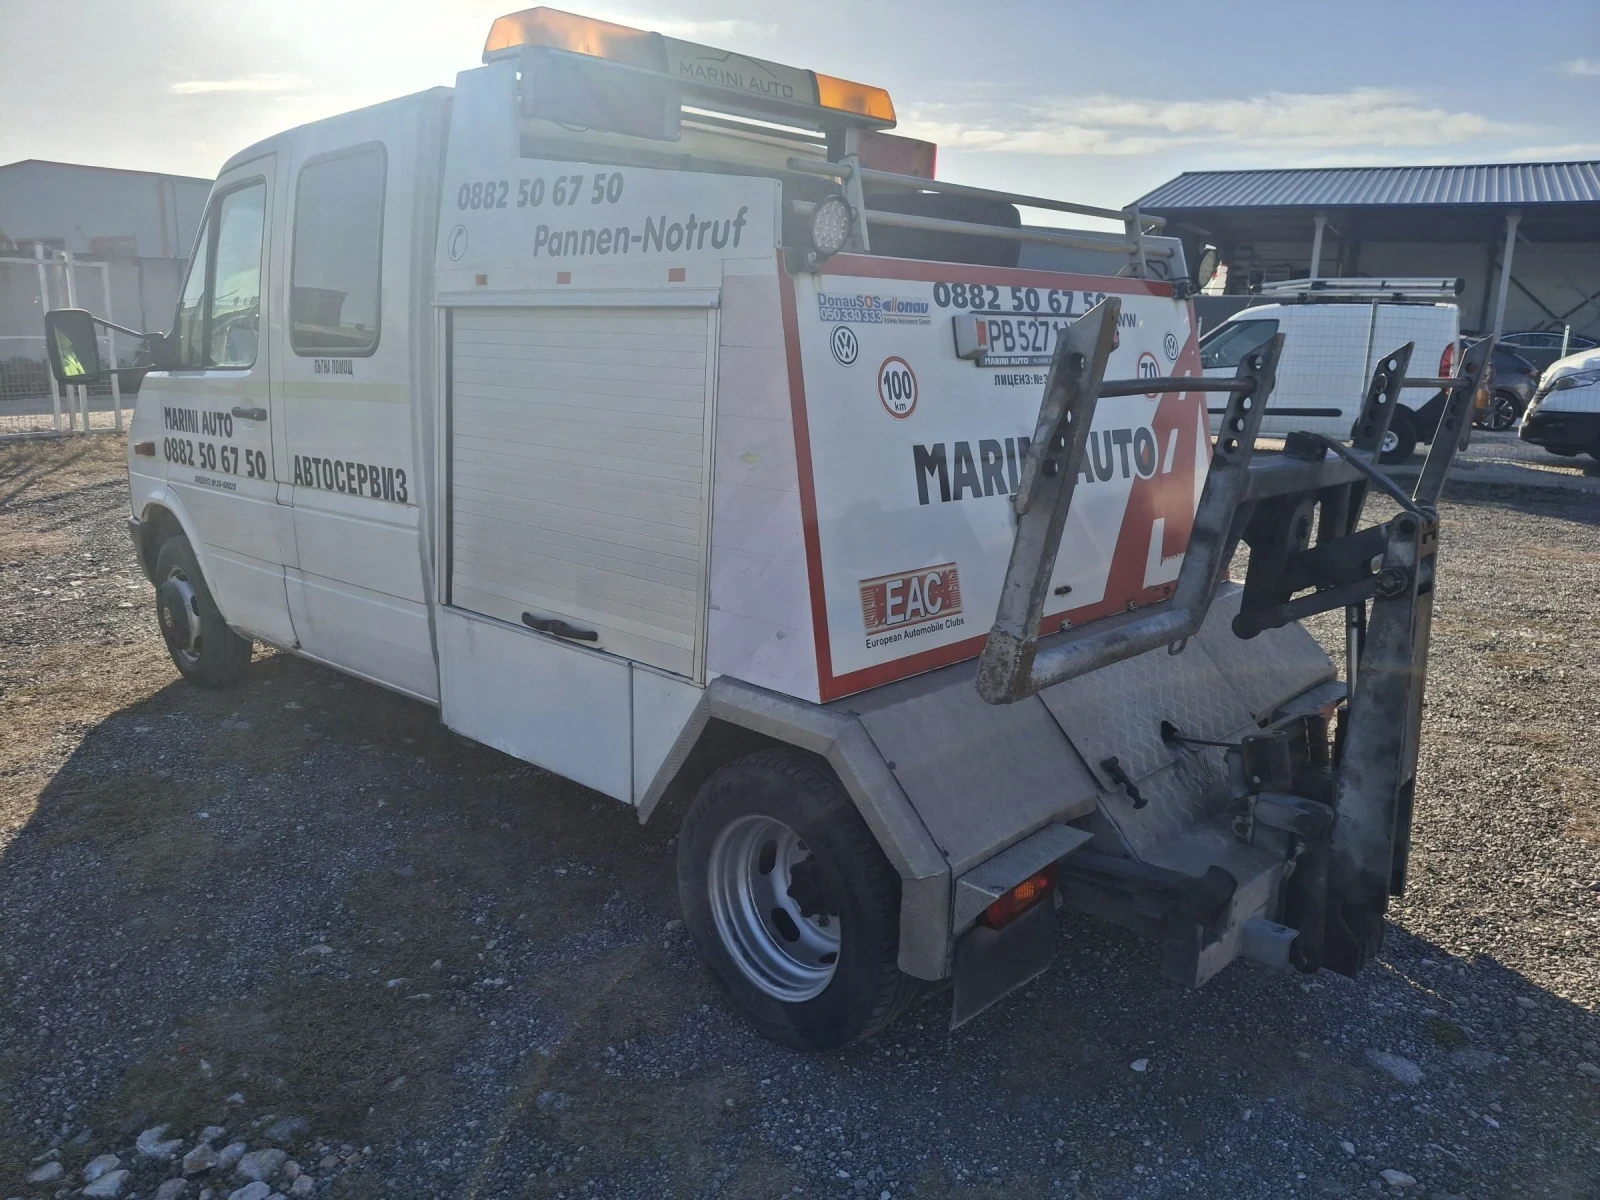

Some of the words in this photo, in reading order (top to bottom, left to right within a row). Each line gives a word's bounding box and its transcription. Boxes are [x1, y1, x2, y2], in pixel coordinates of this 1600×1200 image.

[679, 60, 743, 88] MARINI
[749, 77, 793, 99] AUTO
[457, 180, 509, 211] 0882
[516, 177, 545, 208] 50
[552, 174, 584, 207] 67
[590, 171, 624, 205] 50
[533, 205, 748, 257] Pannen-Notruf
[817, 292, 881, 309] DonauSOS
[933, 281, 1000, 310] 0882
[1011, 286, 1040, 312] 50
[1048, 288, 1074, 314] 67
[984, 357, 1009, 365] MARINI
[1010, 357, 1029, 365] AUTO
[883, 370, 912, 400] 100
[164, 406, 199, 434] MARINI
[202, 411, 233, 438] AUTO
[894, 401, 907, 411] km
[164, 436, 195, 467] 0882
[198, 441, 217, 471] 50
[220, 445, 239, 474] 67
[245, 448, 267, 480] 50
[294, 454, 409, 504] АВТОСЕРВИЗ
[885, 571, 943, 626] EAC
[865, 633, 903, 649] European
[903, 622, 944, 640] Automobile
[945, 617, 965, 630] Clubs
